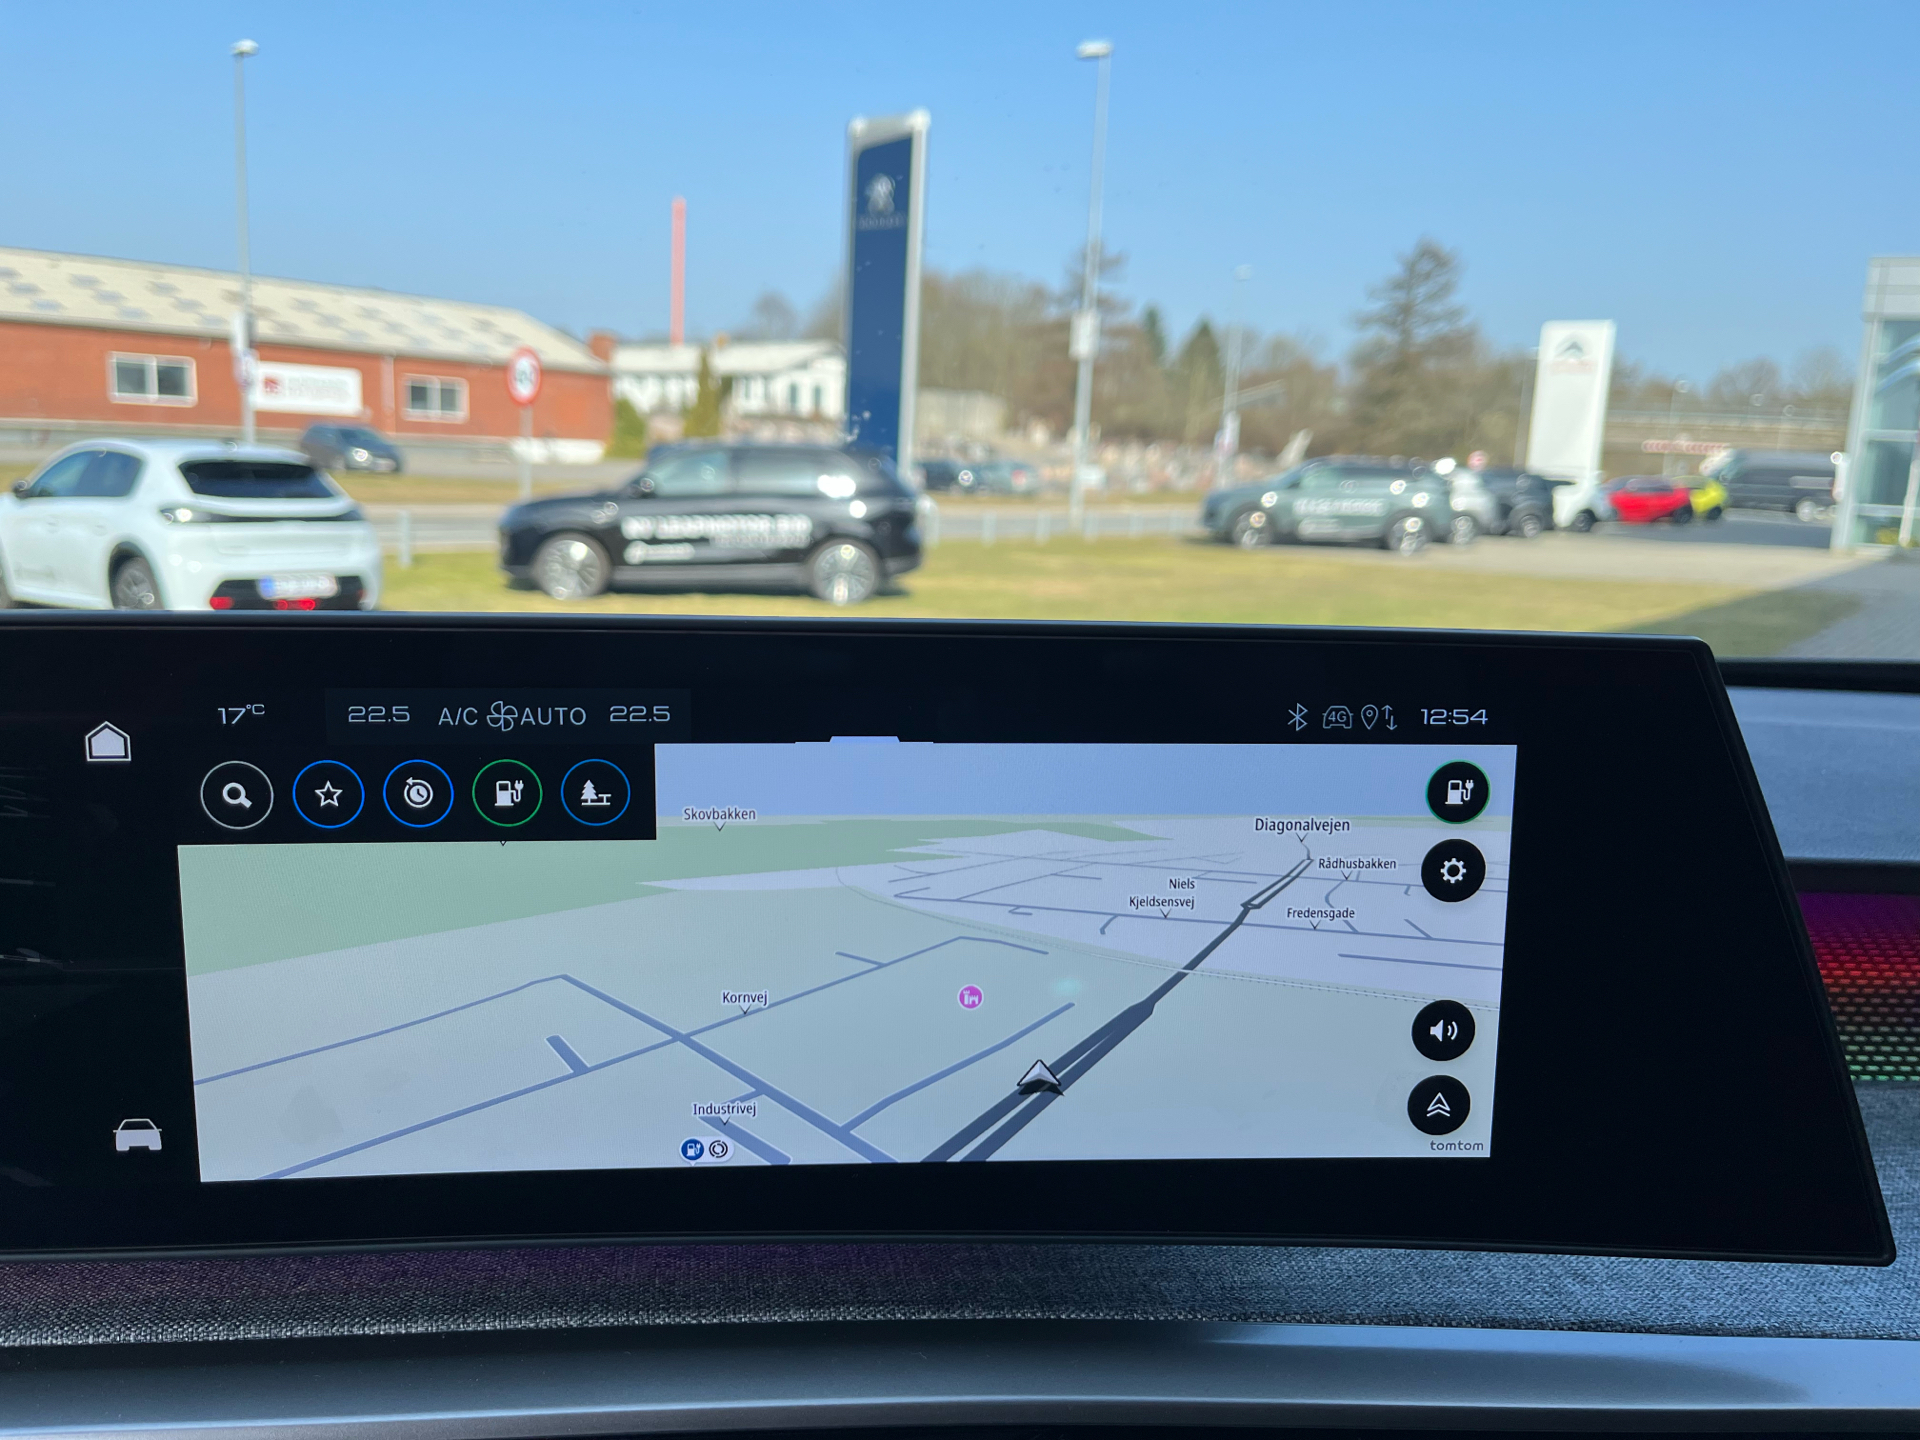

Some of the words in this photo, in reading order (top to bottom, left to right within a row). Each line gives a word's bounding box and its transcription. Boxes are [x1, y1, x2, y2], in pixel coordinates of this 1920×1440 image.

[348, 705, 410, 723] 22.5
[438, 707, 478, 726] A/C
[520, 706, 587, 726] AUTO
[609, 705, 671, 722] 22.5
[1327, 711, 1347, 723] 4G
[1420, 708, 1489, 725] 12:54
[683, 807, 756, 820] Skovbakken
[1254, 818, 1350, 834] Diagonalvejen
[1318, 857, 1397, 870] Rådhusbakken
[1168, 877, 1196, 890] Niels
[1128, 895, 1195, 910] Kjeldsensvej
[1286, 907, 1355, 920] Fredensgade
[722, 990, 768, 1006] Kornvej
[692, 1102, 757, 1117] Industrivej
[1430, 1140, 1484, 1151] tomtom
